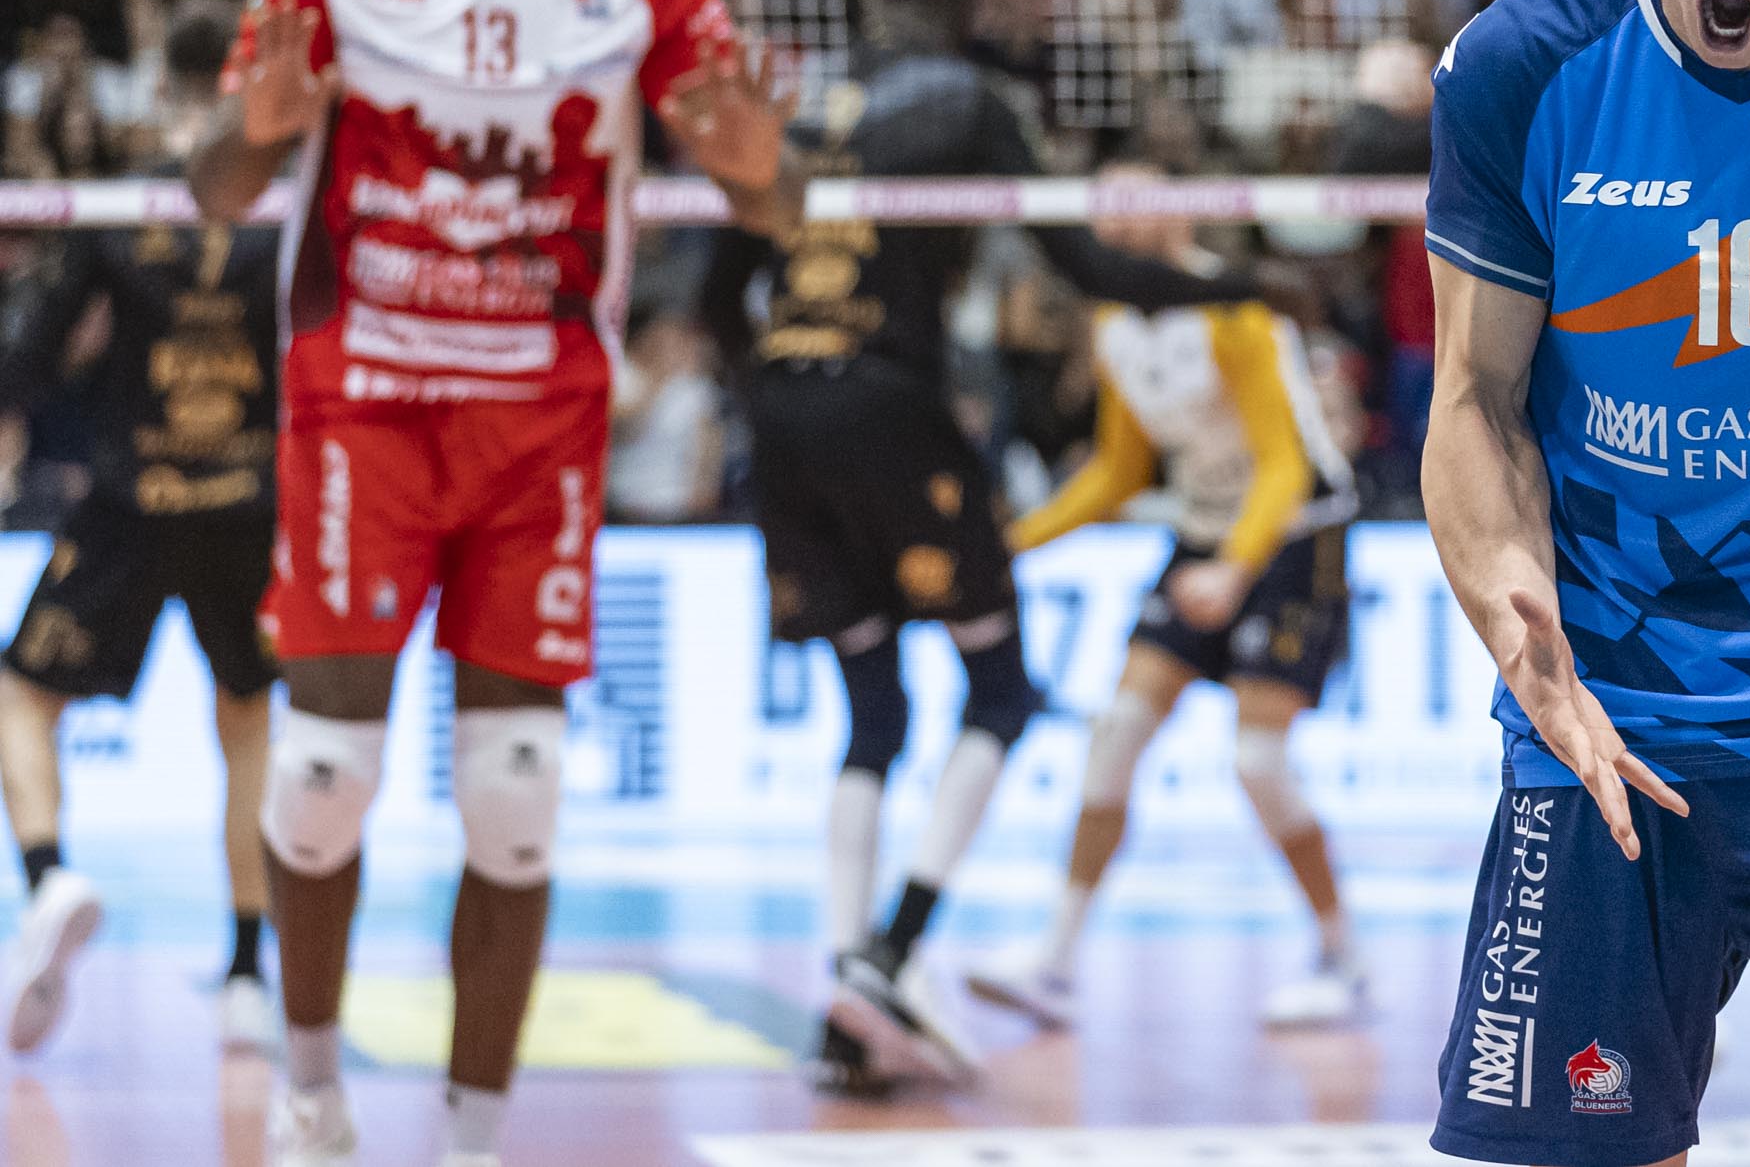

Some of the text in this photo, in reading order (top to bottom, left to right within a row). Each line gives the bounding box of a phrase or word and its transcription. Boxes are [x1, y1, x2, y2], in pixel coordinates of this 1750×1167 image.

[462, 7, 517, 81] 13
[1561, 172, 1692, 207] Zeus
[1482, 795, 1532, 1003] GAS LES
[1510, 799, 1555, 1004] ENERGIA
[1574, 1100, 1628, 1110] BLUENERGY
[1577, 1091, 1626, 1101] GAS SALES
